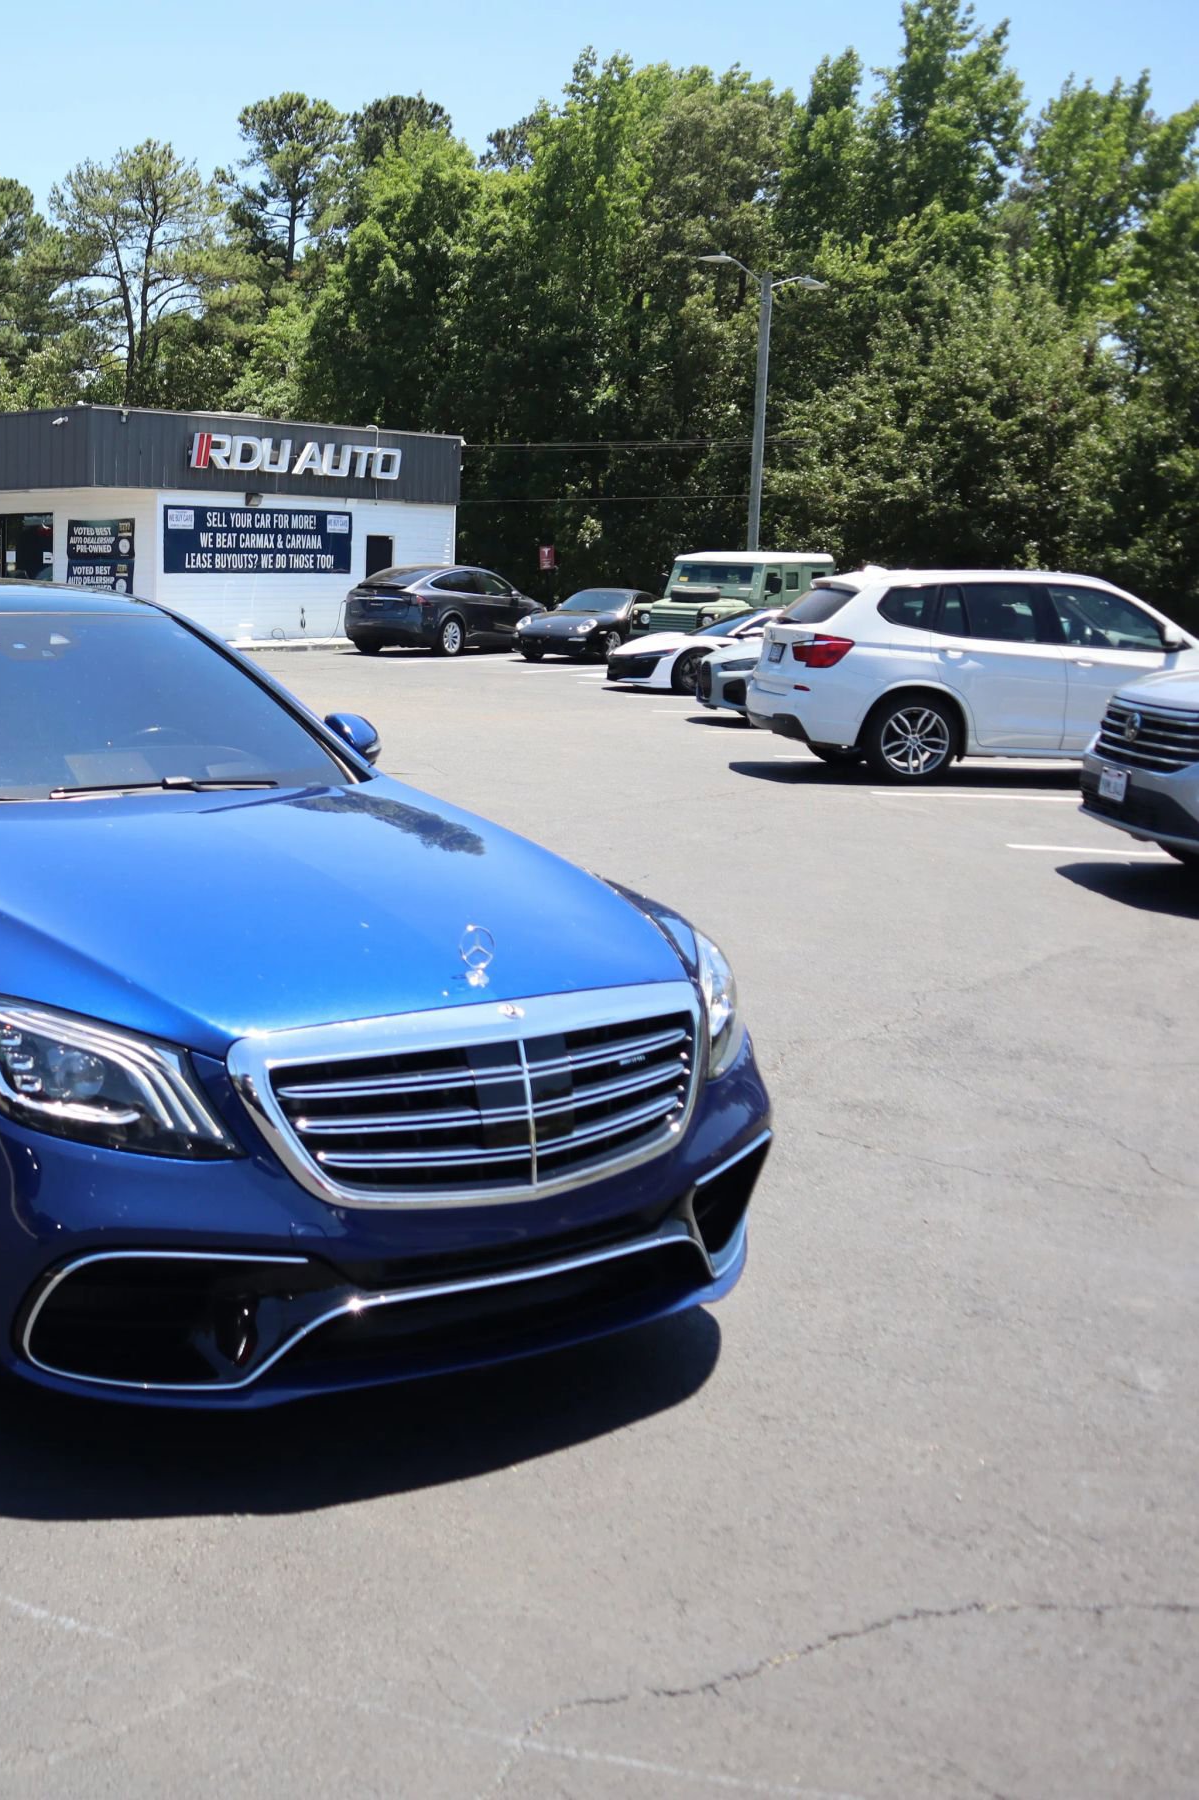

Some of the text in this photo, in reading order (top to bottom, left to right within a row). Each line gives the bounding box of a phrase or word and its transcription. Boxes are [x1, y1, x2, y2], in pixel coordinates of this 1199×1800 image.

[190, 432, 402, 480] RDU AUTO
[206, 512, 317, 530] SELL YOUR CAR FOR MORE!
[73, 527, 94, 535] VOTED
[95, 527, 112, 536] BEST
[69, 536, 116, 544] AUTO DEALERSHIP
[200, 532, 322, 549] WE BEAT CARMAX & CARVANA
[76, 544, 112, 553] PRE-OWNED
[185, 553, 334, 569] LEASE BUYOUTS? WE DO THOSE TOO!
[72, 566, 94, 575] VOTED
[95, 566, 111, 575] BEST
[68, 576, 115, 585] AUTO DEALERSHIP
